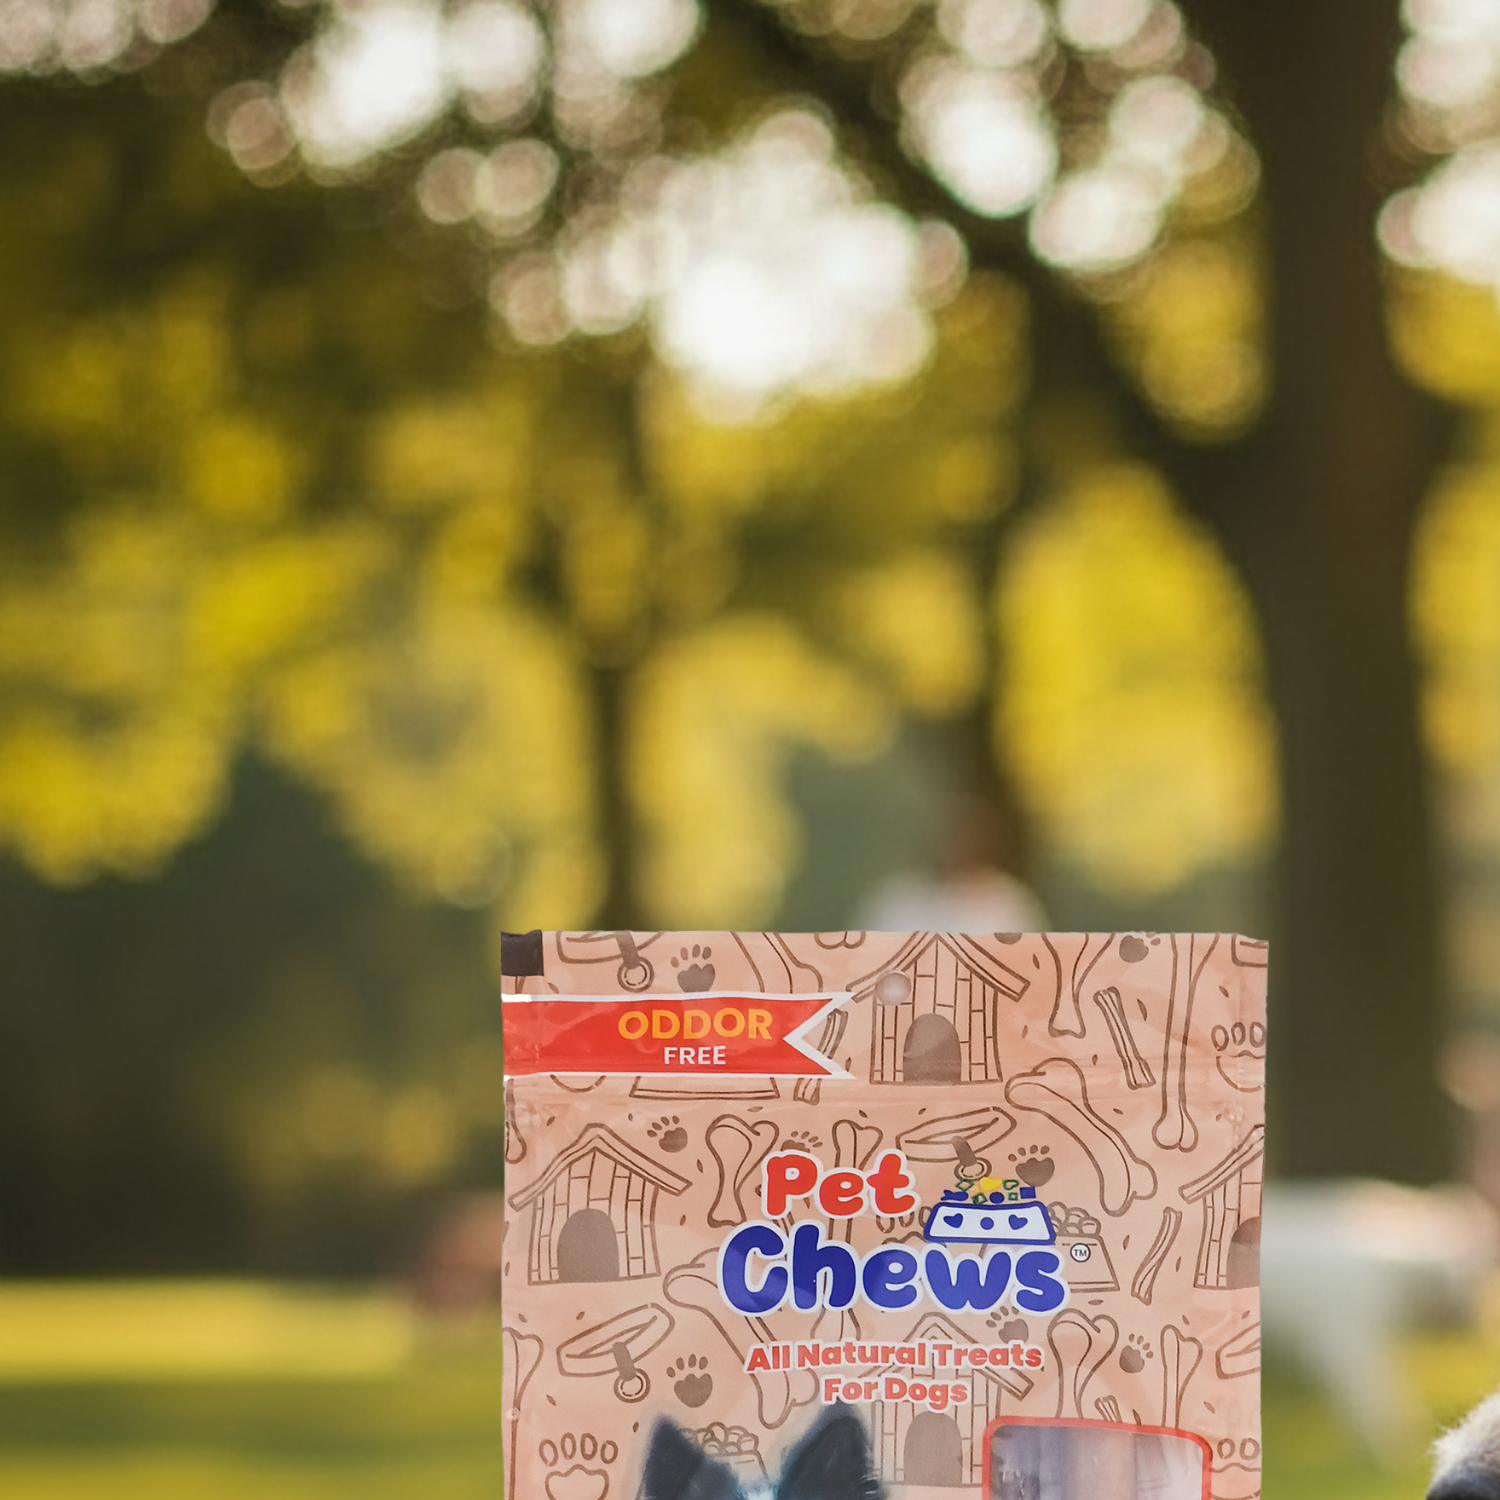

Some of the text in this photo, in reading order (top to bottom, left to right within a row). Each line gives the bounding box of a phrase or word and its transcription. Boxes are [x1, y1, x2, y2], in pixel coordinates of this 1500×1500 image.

[617, 1007, 773, 1040] ODDOR
[663, 1045, 726, 1065] FREE
[766, 1152, 916, 1217] Pet
[722, 1223, 1066, 1314] Chews
[746, 1342, 1043, 1371] All Natural Treats
[824, 1377, 968, 1412] For Dogs
